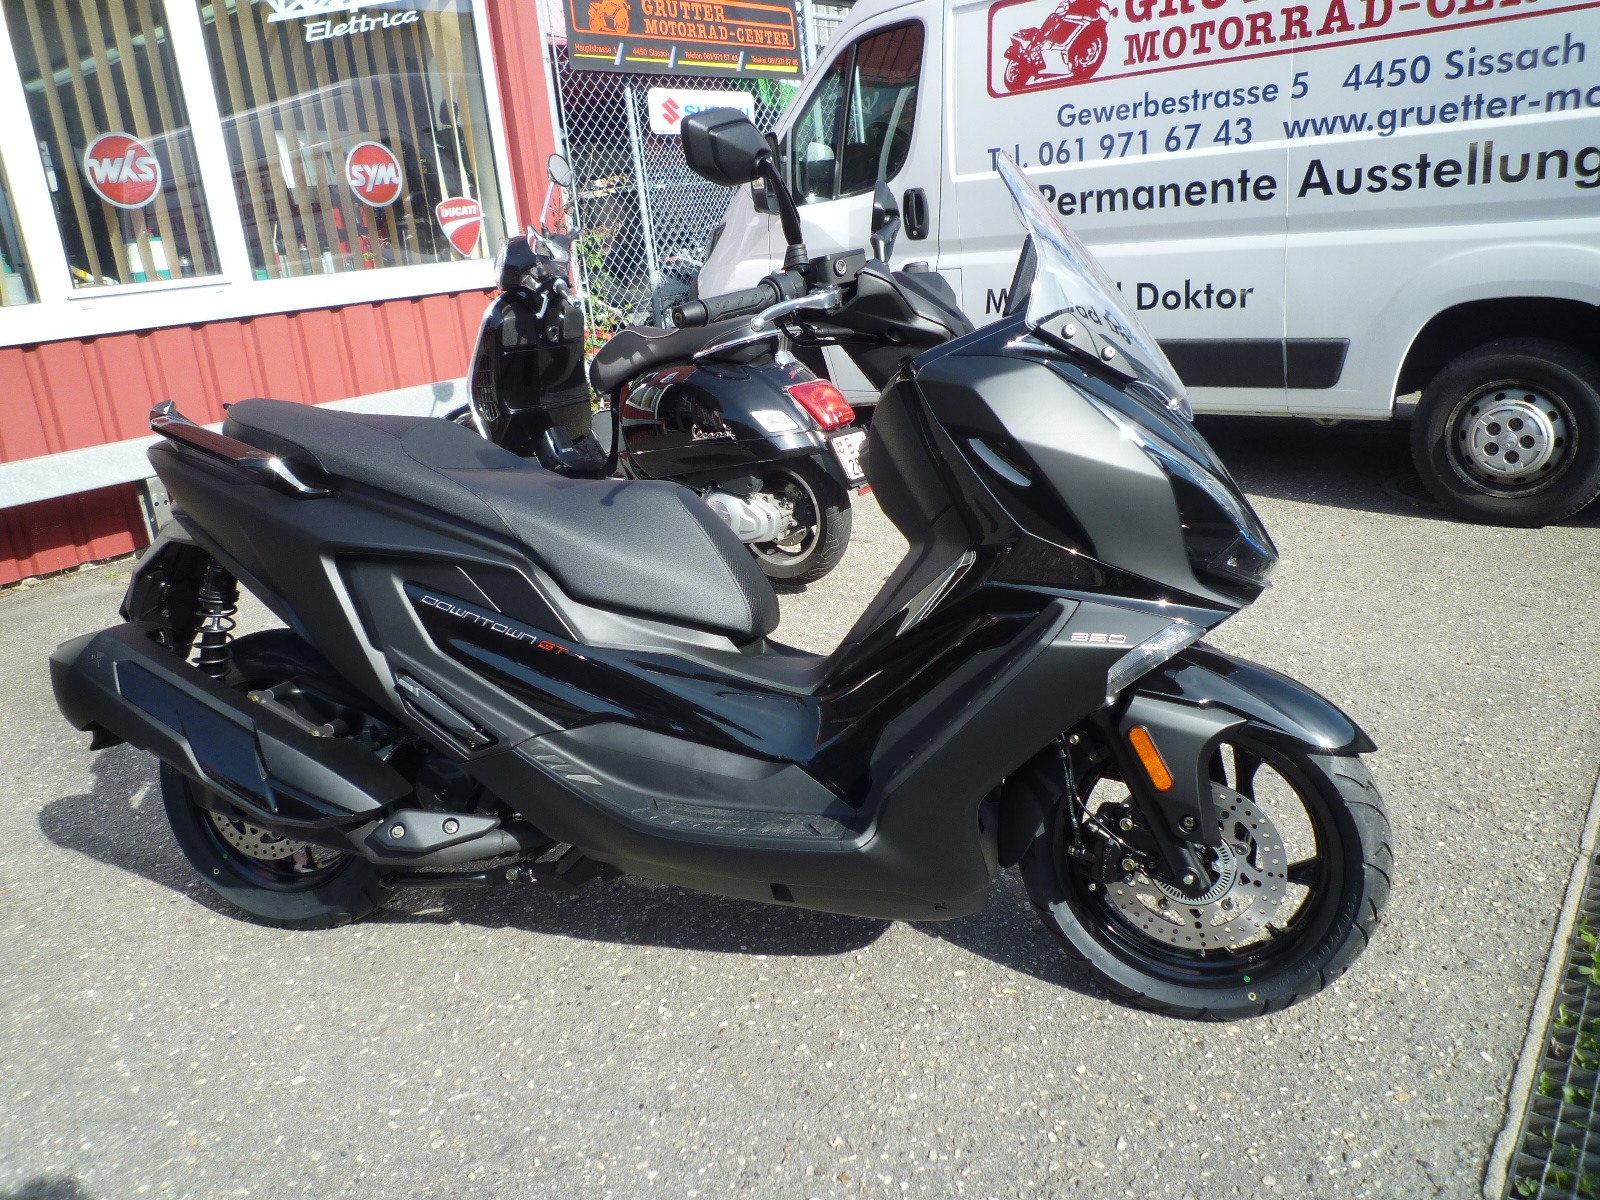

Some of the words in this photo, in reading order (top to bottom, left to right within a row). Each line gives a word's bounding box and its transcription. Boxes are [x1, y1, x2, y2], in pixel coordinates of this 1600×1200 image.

[303, 10, 420, 43] Elettrica
[643, 18, 791, 47] MOTORRAD-CENTER
[574, 42, 612, 54] Hauptstrasse
[632, 47, 648, 56] 4450
[649, 48, 670, 58] Sissach
[684, 51, 703, 60] Telefon
[1057, 83, 1279, 128] Gewerbestrasse
[1290, 71, 1309, 99] 5
[1341, 54, 1431, 92] 4450
[1444, 32, 1586, 80] Sissach
[987, 143, 1028, 171] Tl.
[1038, 138, 1085, 167] 061
[1099, 129, 1149, 160] 971
[1164, 123, 1202, 152] 67
[1213, 117, 1253, 147] 43
[88, 150, 158, 184] WKS
[350, 162, 401, 193] SYM
[1297, 140, 1600, 198] Ausstellung
[441, 205, 478, 218] DUCATI
[1136, 279, 1255, 311] Doktor
[420, 595, 537, 645] DOWNTOWN
[536, 639, 570, 655] GT
[1070, 632, 1127, 645] 350
